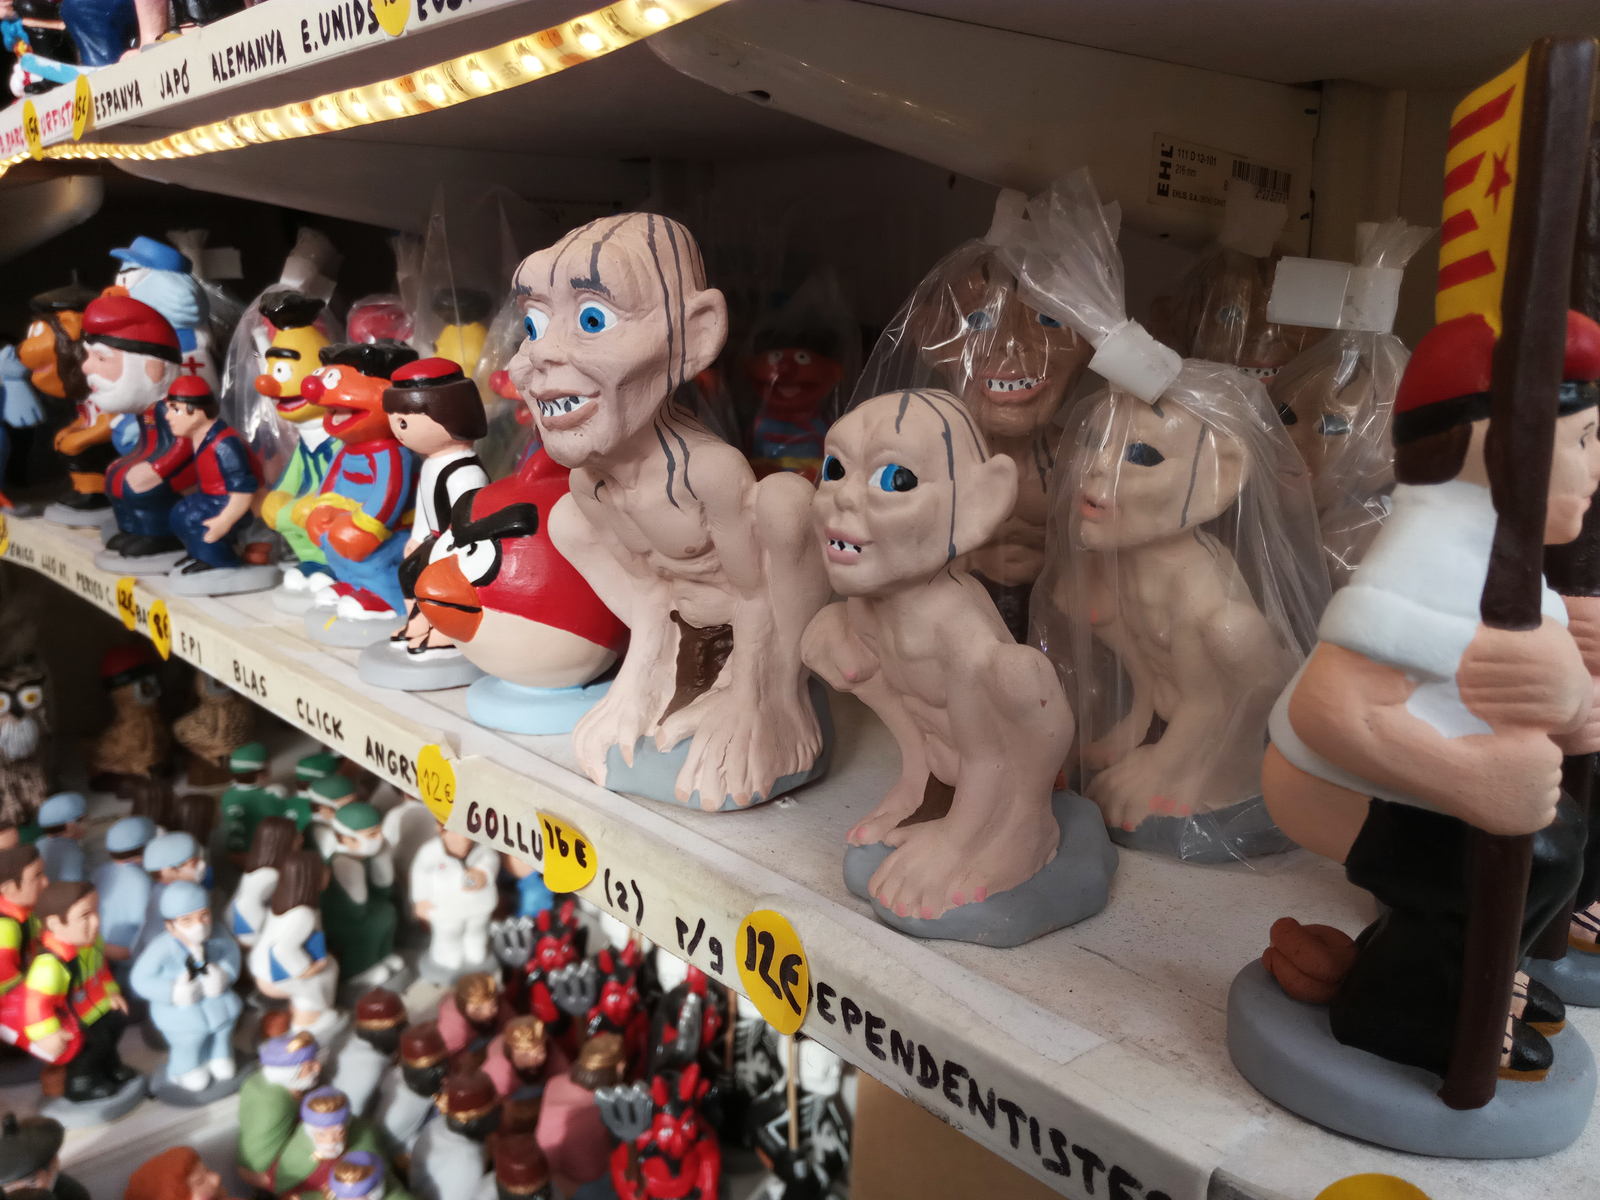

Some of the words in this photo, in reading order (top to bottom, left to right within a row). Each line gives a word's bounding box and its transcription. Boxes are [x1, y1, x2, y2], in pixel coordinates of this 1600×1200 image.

[211, 29, 287, 83] ALEMANYA
[94, 79, 143, 121] ESPANYA
[1175, 164, 1186, 176] 216
[1186, 168, 1197, 178] mm
[1177, 148, 1188, 160] 111
[1190, 151, 1196, 162] D
[1196, 153, 1217, 167] 12-101
[1172, 189, 1189, 201] EHLIS,
[135, 604, 150, 627] BA
[180, 631, 202, 664] EPI
[233, 660, 267, 698] BLAS
[296, 697, 344, 741] CLICK
[423, 767, 454, 804] 12€
[466, 801, 543, 862] GOLLU
[604, 868, 644, 926] (2)
[745, 925, 803, 1016] 12€
[808, 978, 1172, 1200] EPENDENTISTE
